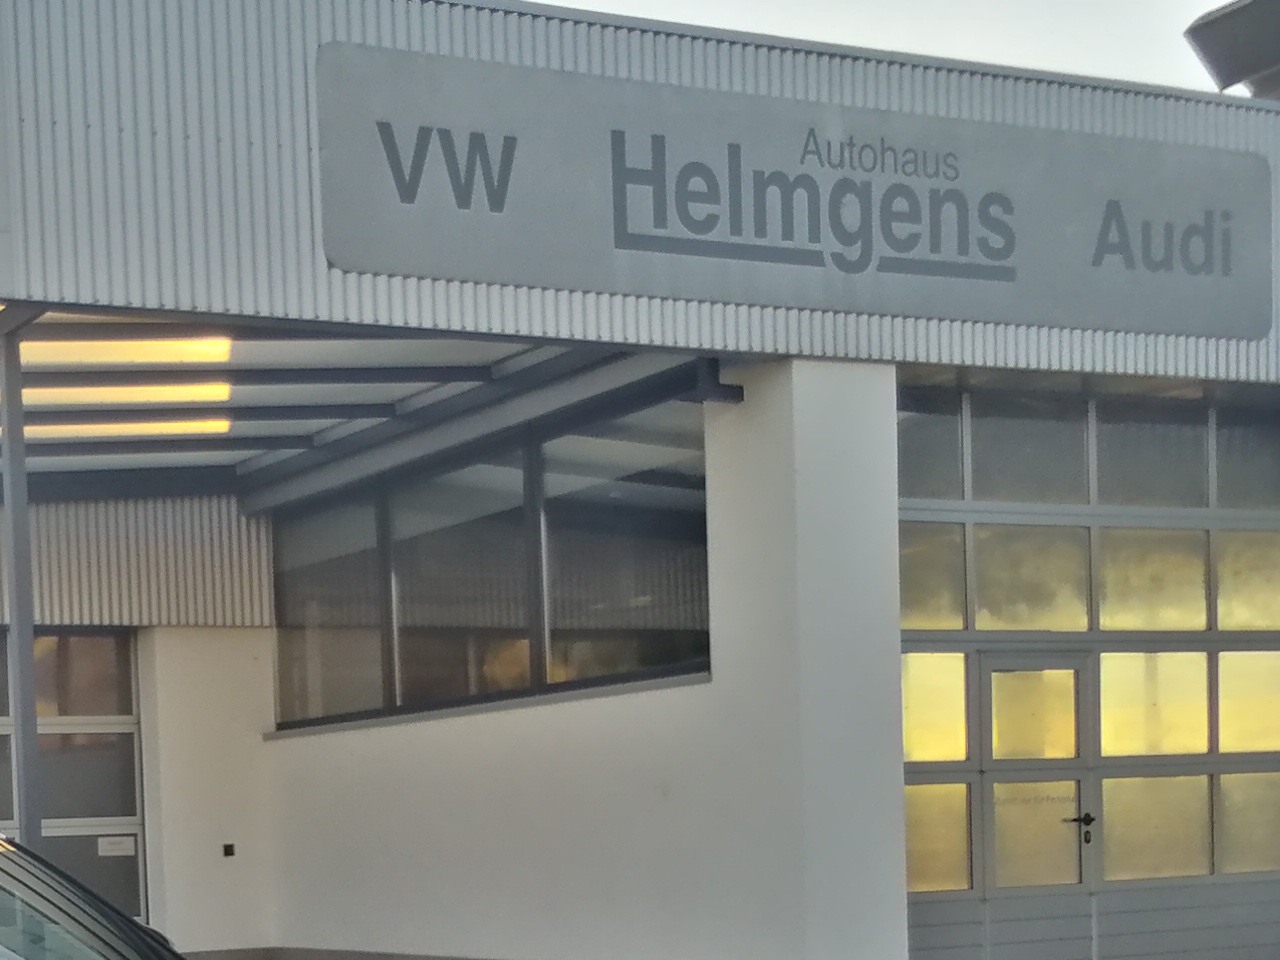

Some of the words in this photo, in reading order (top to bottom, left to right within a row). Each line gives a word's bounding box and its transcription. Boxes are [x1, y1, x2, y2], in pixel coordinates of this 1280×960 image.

[375, 120, 518, 214] VW
[799, 126, 961, 183] Autohaus
[610, 128, 1017, 275] Helmgens
[1091, 198, 1234, 277] Audi
